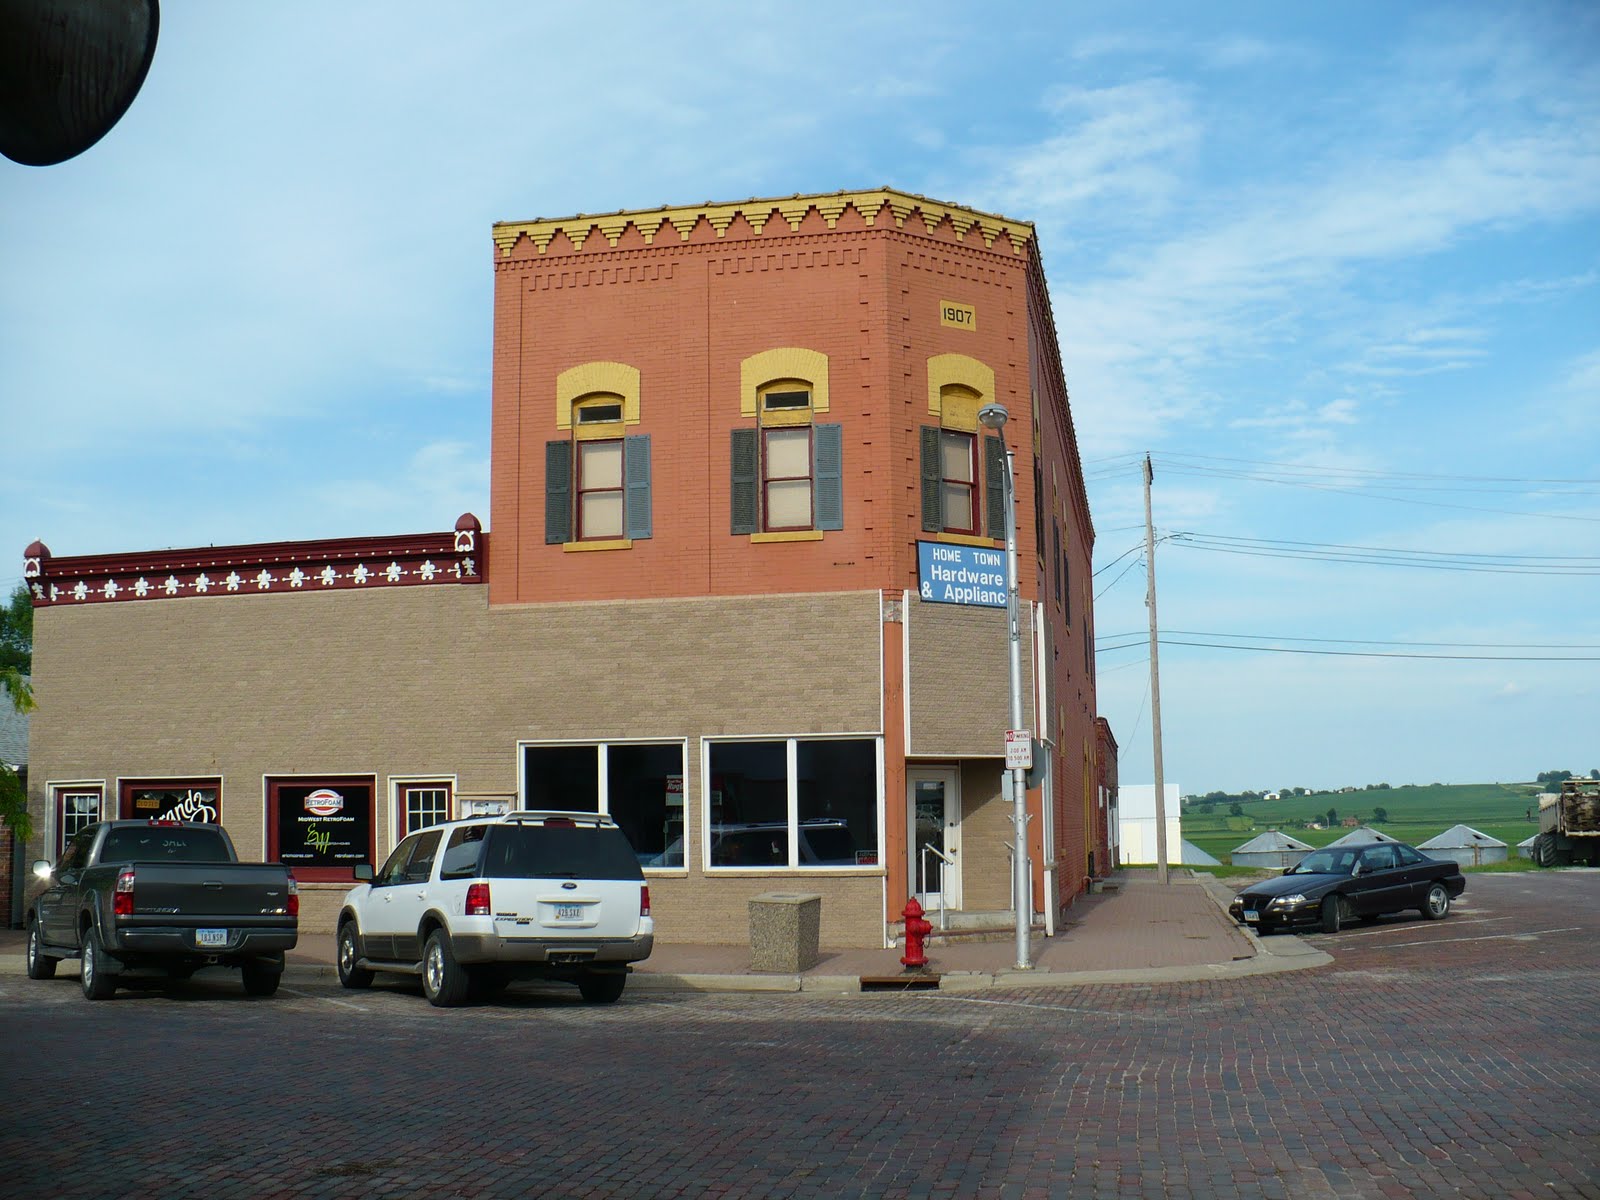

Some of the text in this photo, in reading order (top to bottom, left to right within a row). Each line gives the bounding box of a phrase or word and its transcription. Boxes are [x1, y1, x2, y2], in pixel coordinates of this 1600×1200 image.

[943, 307, 972, 325] 1907
[932, 547, 1001, 567] HOME TOWN
[931, 564, 1004, 587] Hardware
[921, 580, 1007, 604] & Applianc
[1006, 731, 1014, 742] NO
[305, 797, 342, 806] RETROFOAM
